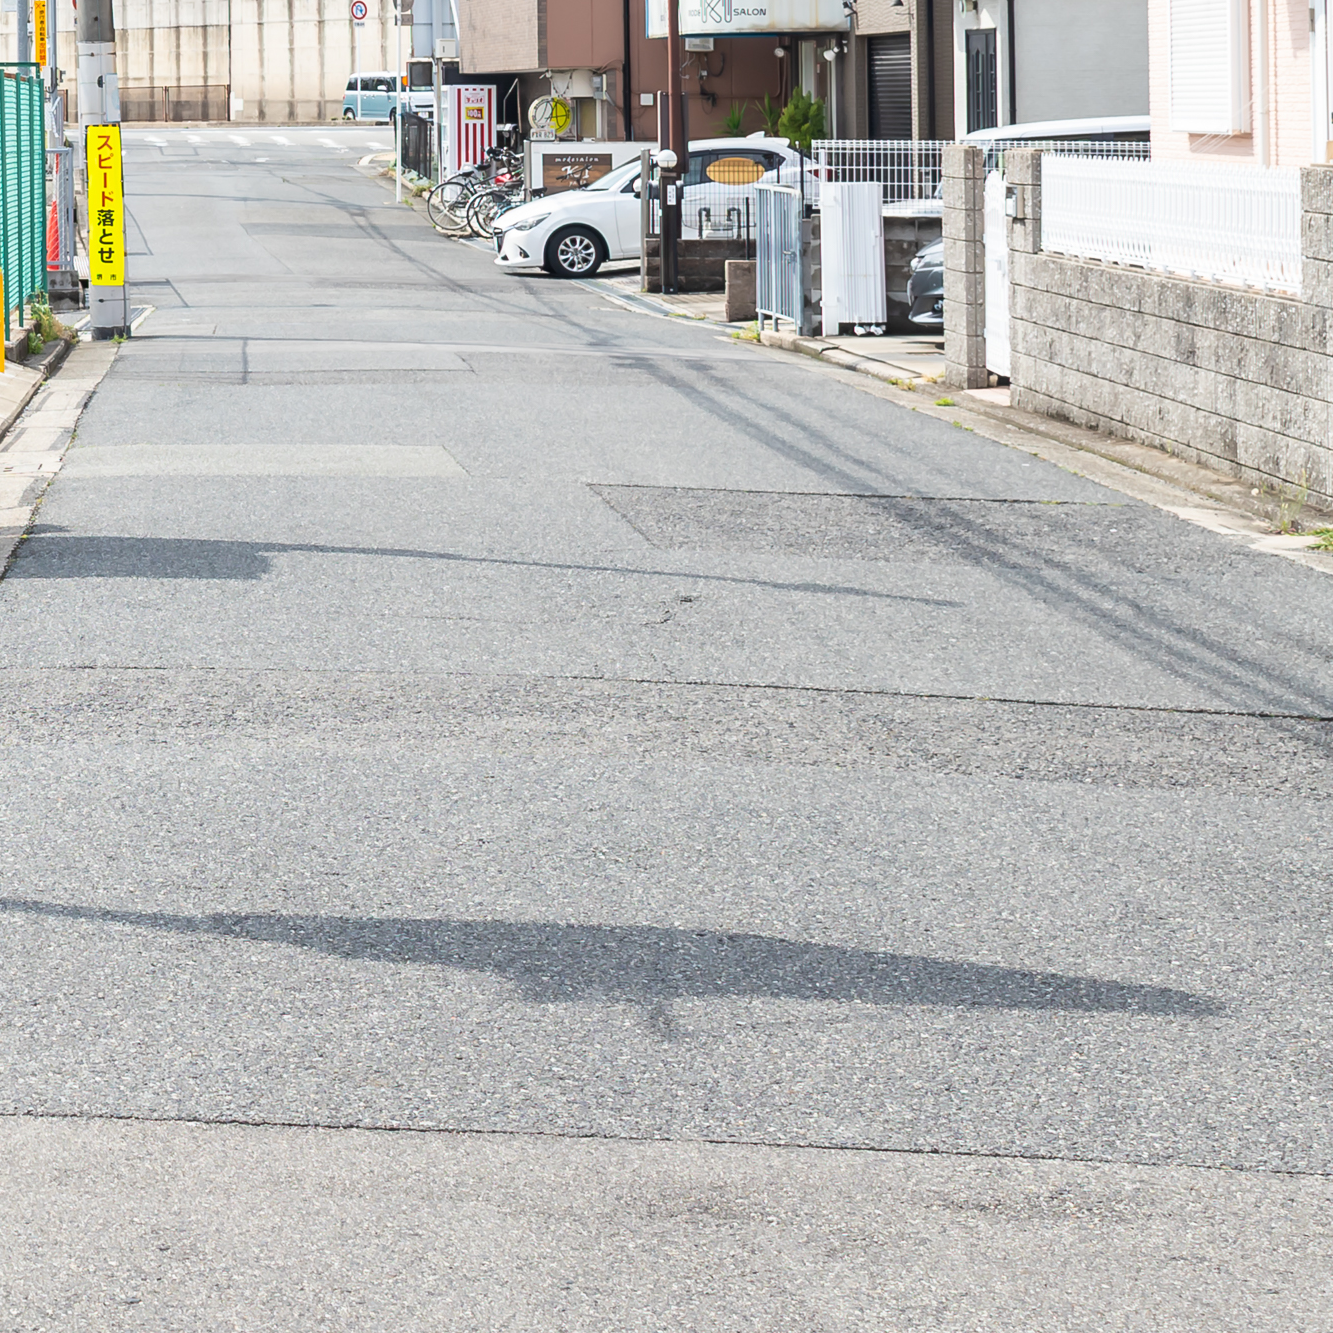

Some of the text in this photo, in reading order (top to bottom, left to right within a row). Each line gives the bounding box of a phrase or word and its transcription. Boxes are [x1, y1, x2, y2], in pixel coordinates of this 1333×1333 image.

[733, 8, 767, 16] SALON
[96, 135, 115, 264] スピード落とせ
